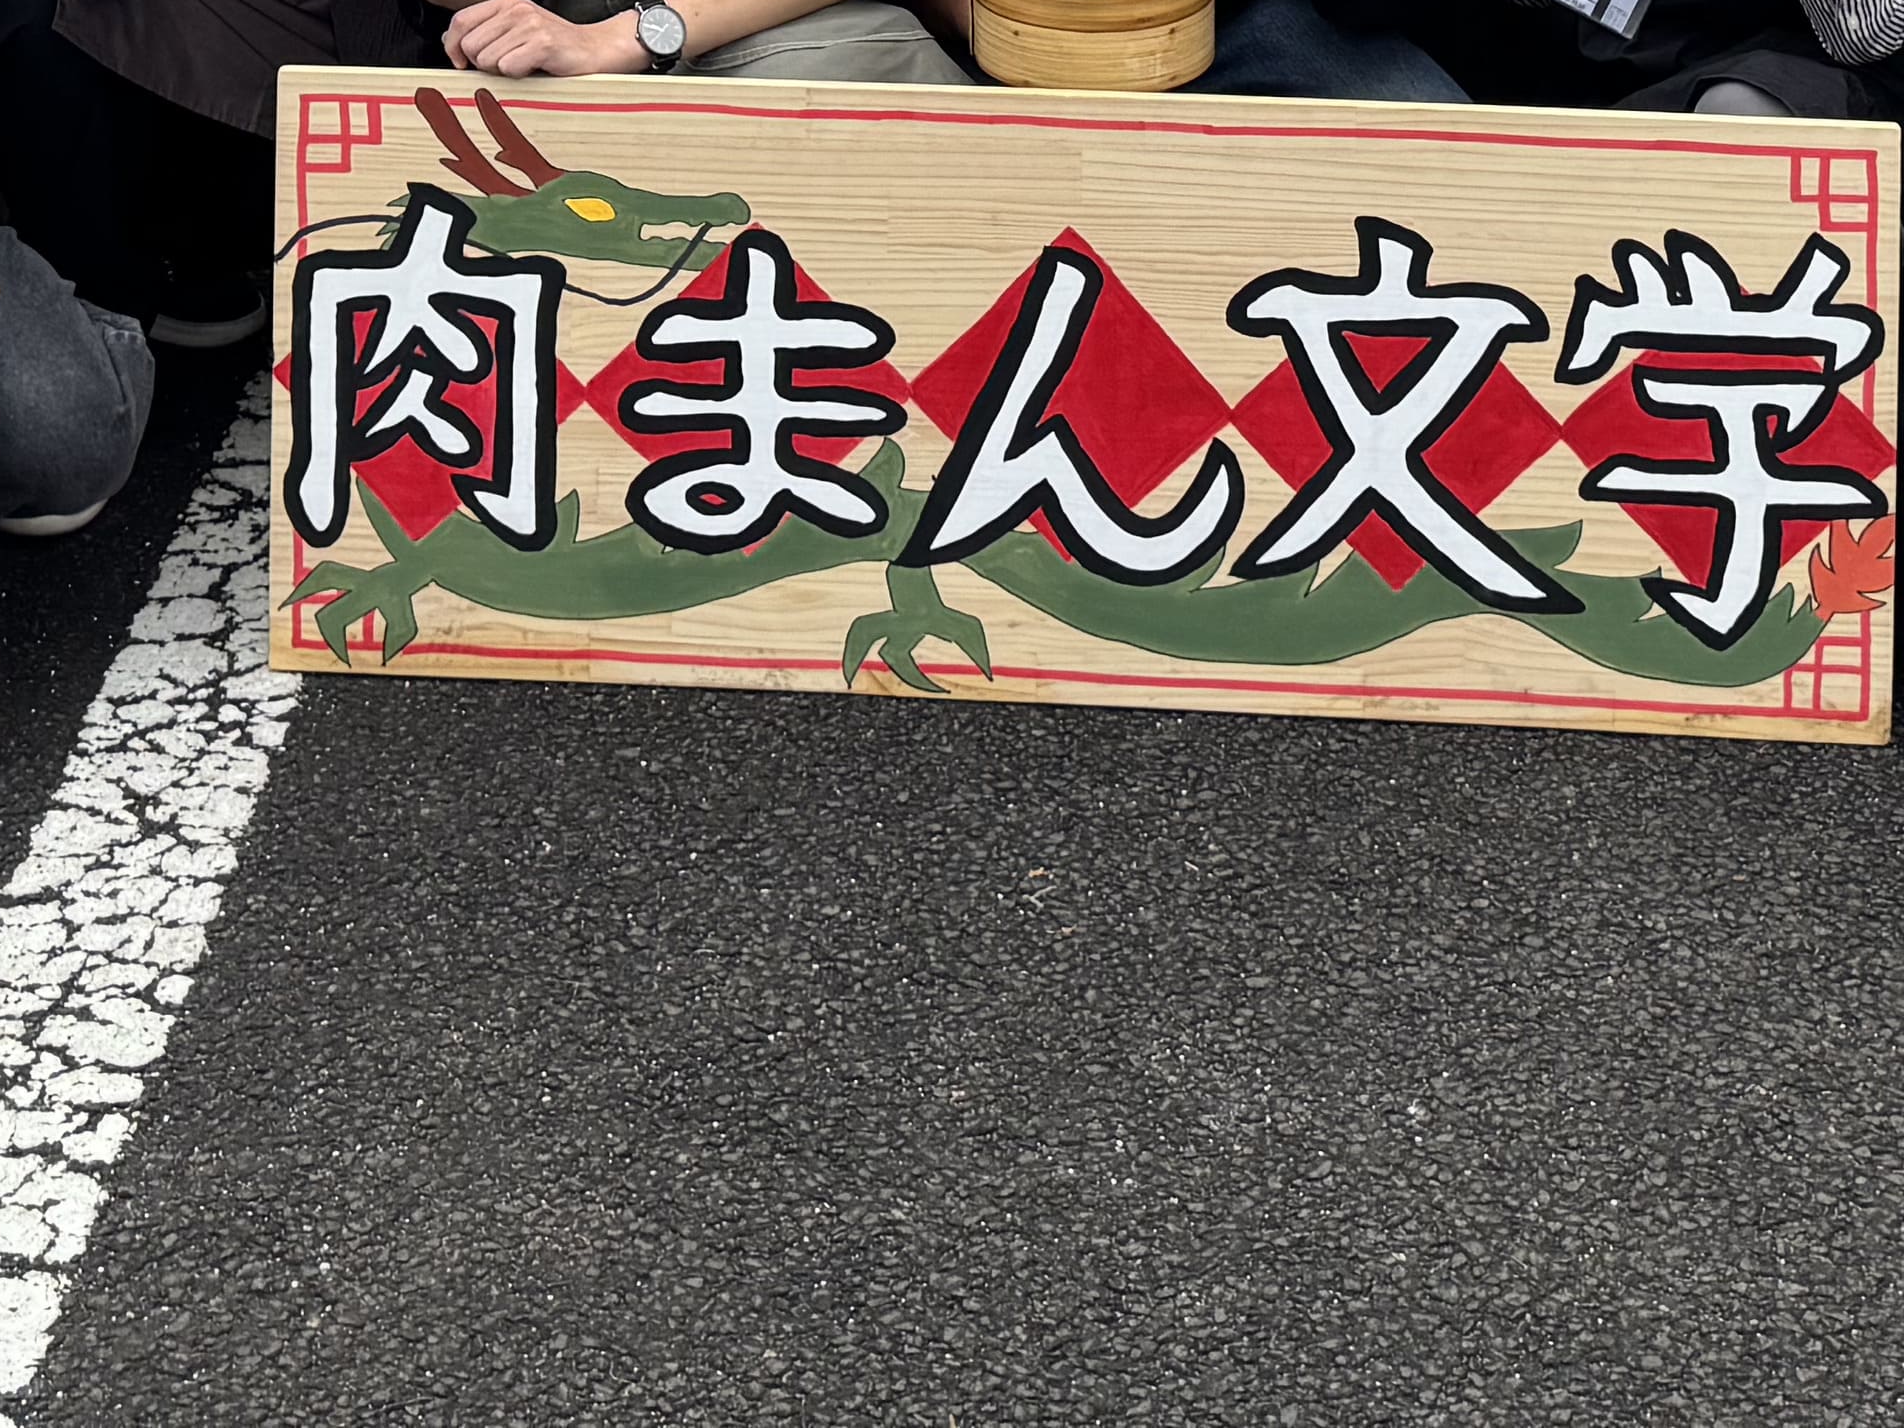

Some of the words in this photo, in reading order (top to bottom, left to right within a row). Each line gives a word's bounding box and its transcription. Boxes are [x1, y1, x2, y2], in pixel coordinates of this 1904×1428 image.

[282, 183, 1886, 648] 肉まん文学
